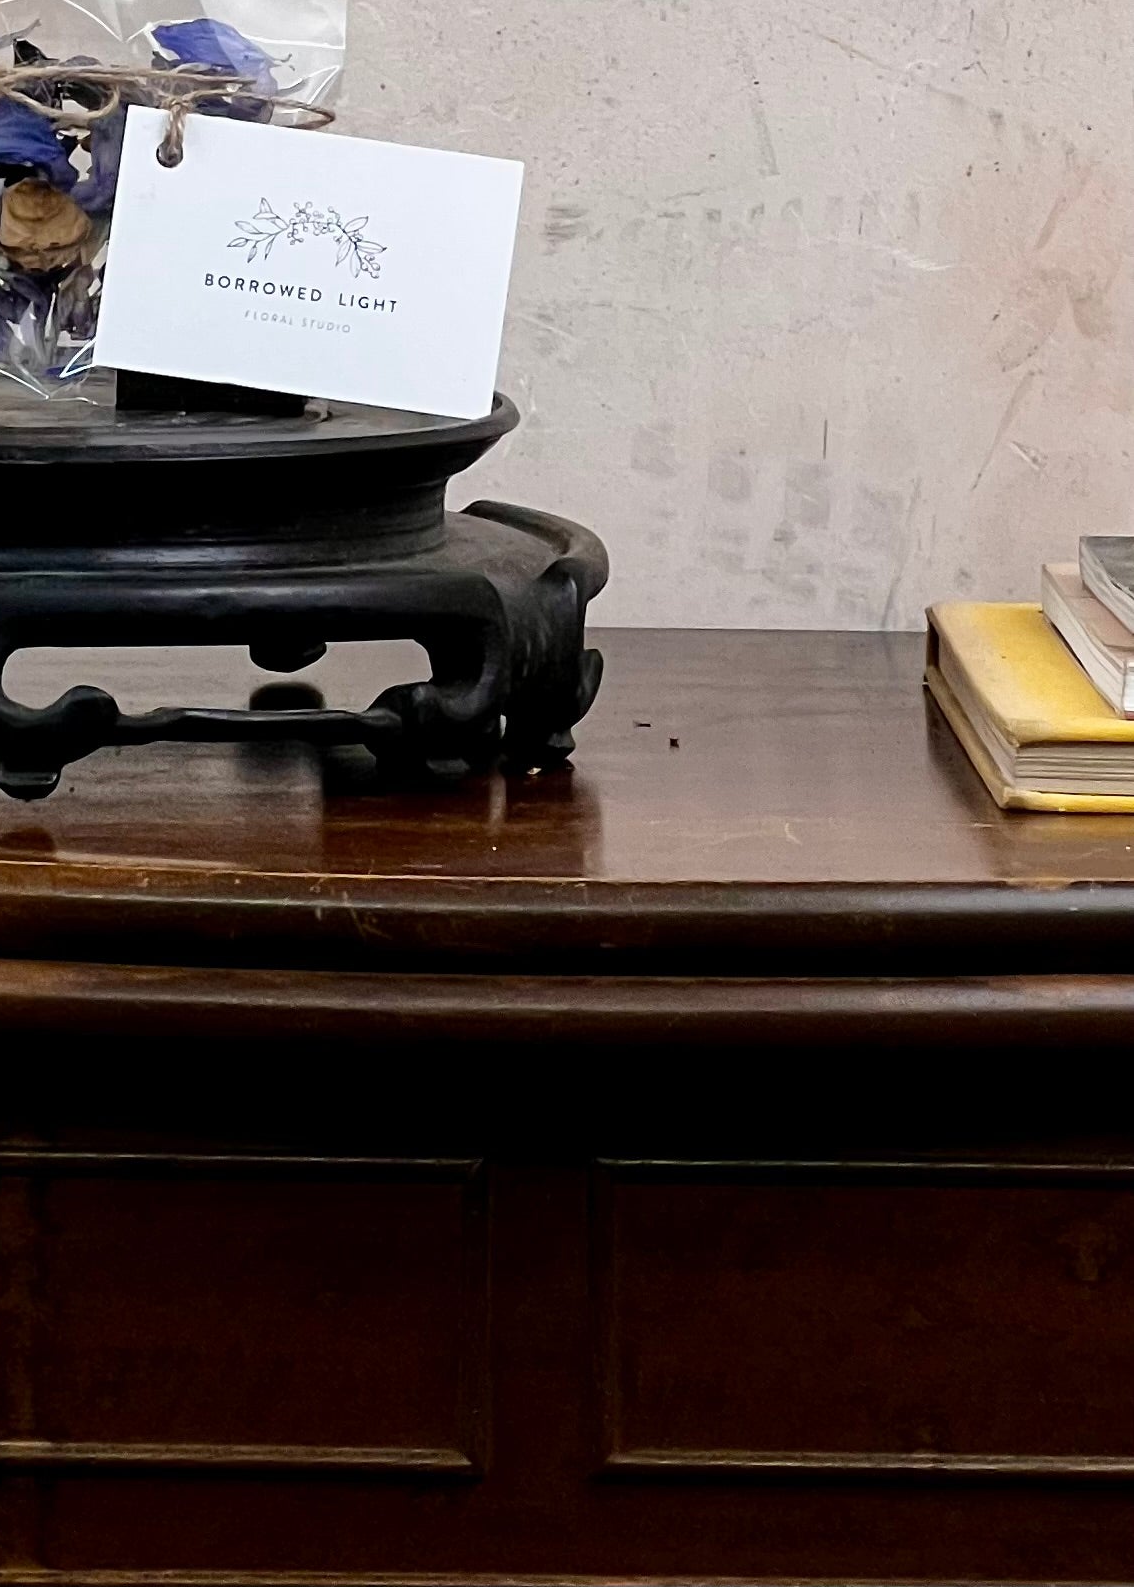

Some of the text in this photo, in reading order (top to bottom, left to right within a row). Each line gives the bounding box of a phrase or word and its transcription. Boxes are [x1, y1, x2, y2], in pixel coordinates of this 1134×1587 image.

[204, 273, 397, 313] BORROWED LIGHT
[244, 309, 351, 333] FLORAL STUDIO
